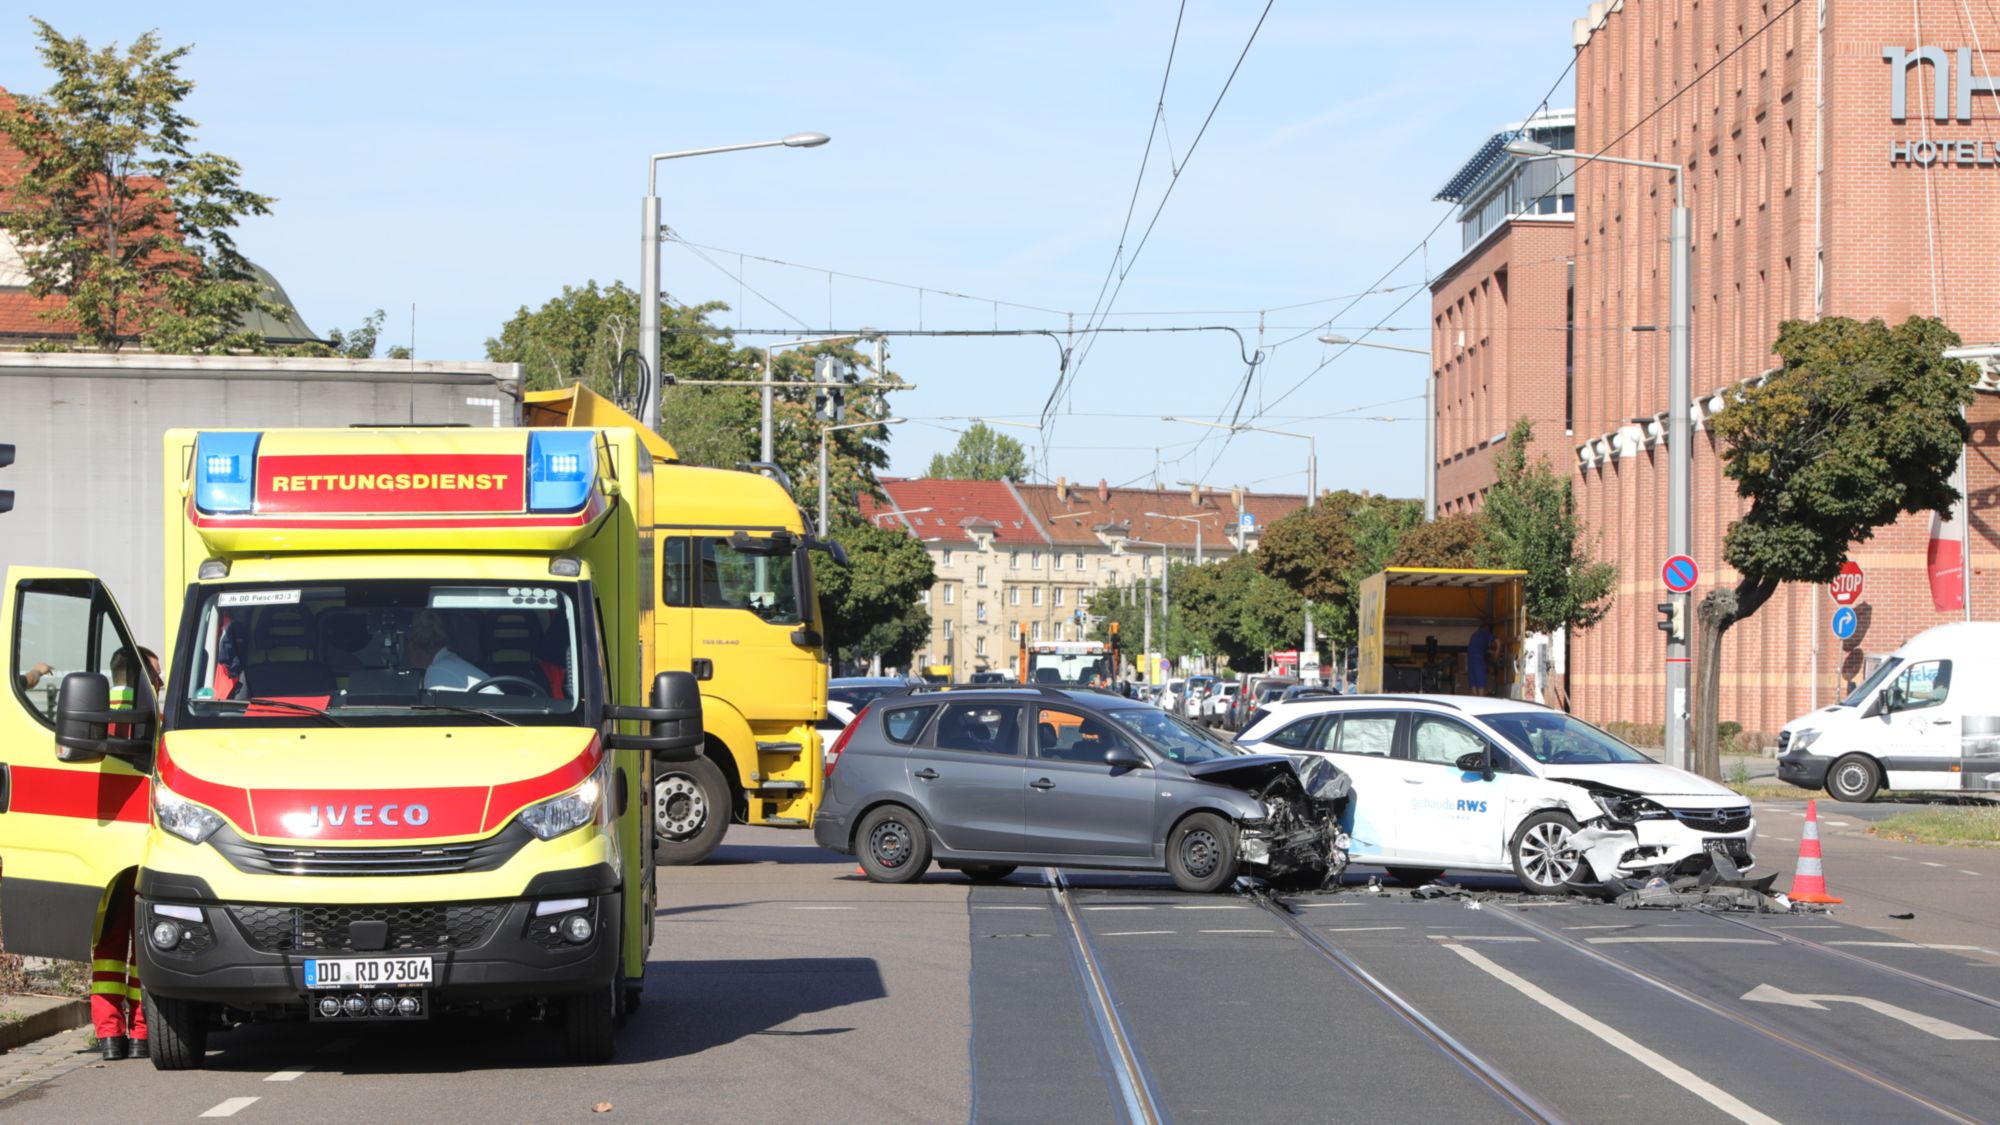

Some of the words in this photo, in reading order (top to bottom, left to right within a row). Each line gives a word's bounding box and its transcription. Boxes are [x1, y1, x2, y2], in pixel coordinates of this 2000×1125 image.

[272, 474, 508, 492] RETTUNGSDIENST
[1831, 574, 1861, 592] STOP
[1457, 799, 1487, 813] RWS
[310, 803, 430, 828] IVECO
[318, 962, 341, 982] DD
[355, 961, 379, 981] RD
[384, 960, 430, 981] 9304
